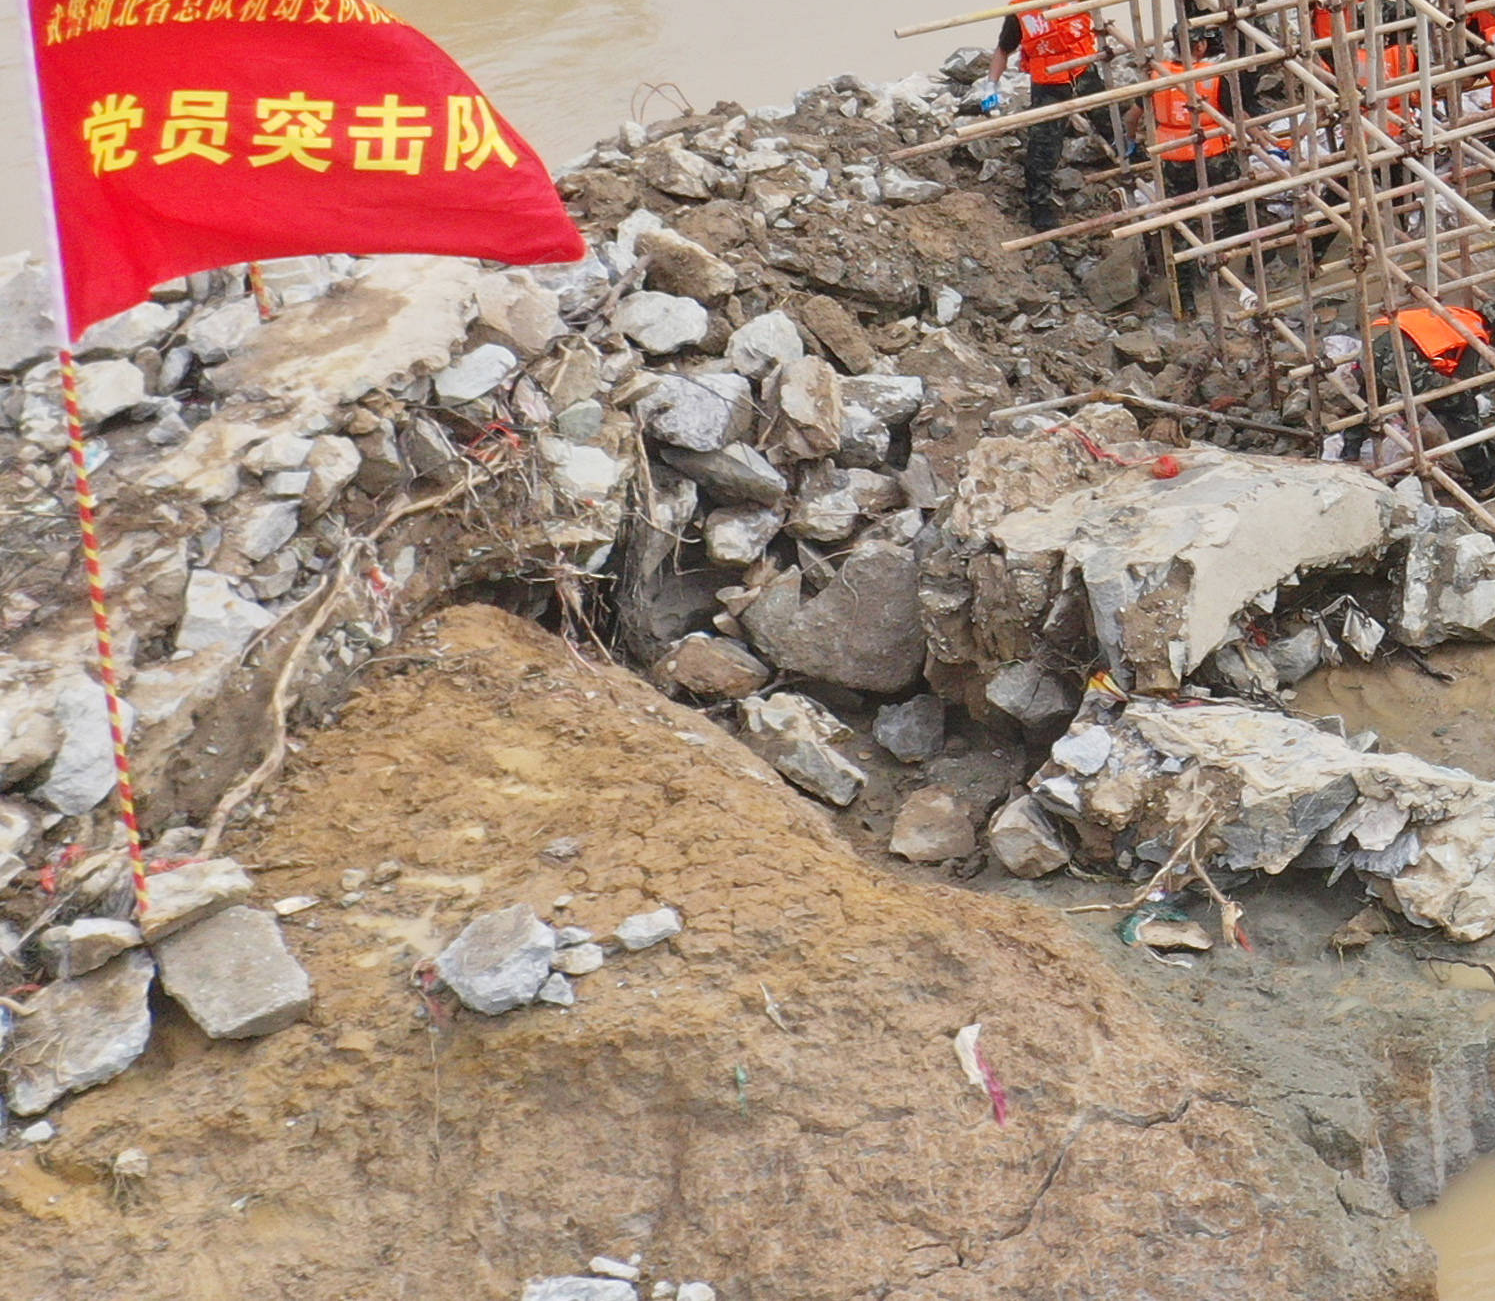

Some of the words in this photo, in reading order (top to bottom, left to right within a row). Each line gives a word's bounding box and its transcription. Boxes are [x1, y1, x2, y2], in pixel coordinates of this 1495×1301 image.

[81, 89, 520, 178] 党员突击队
